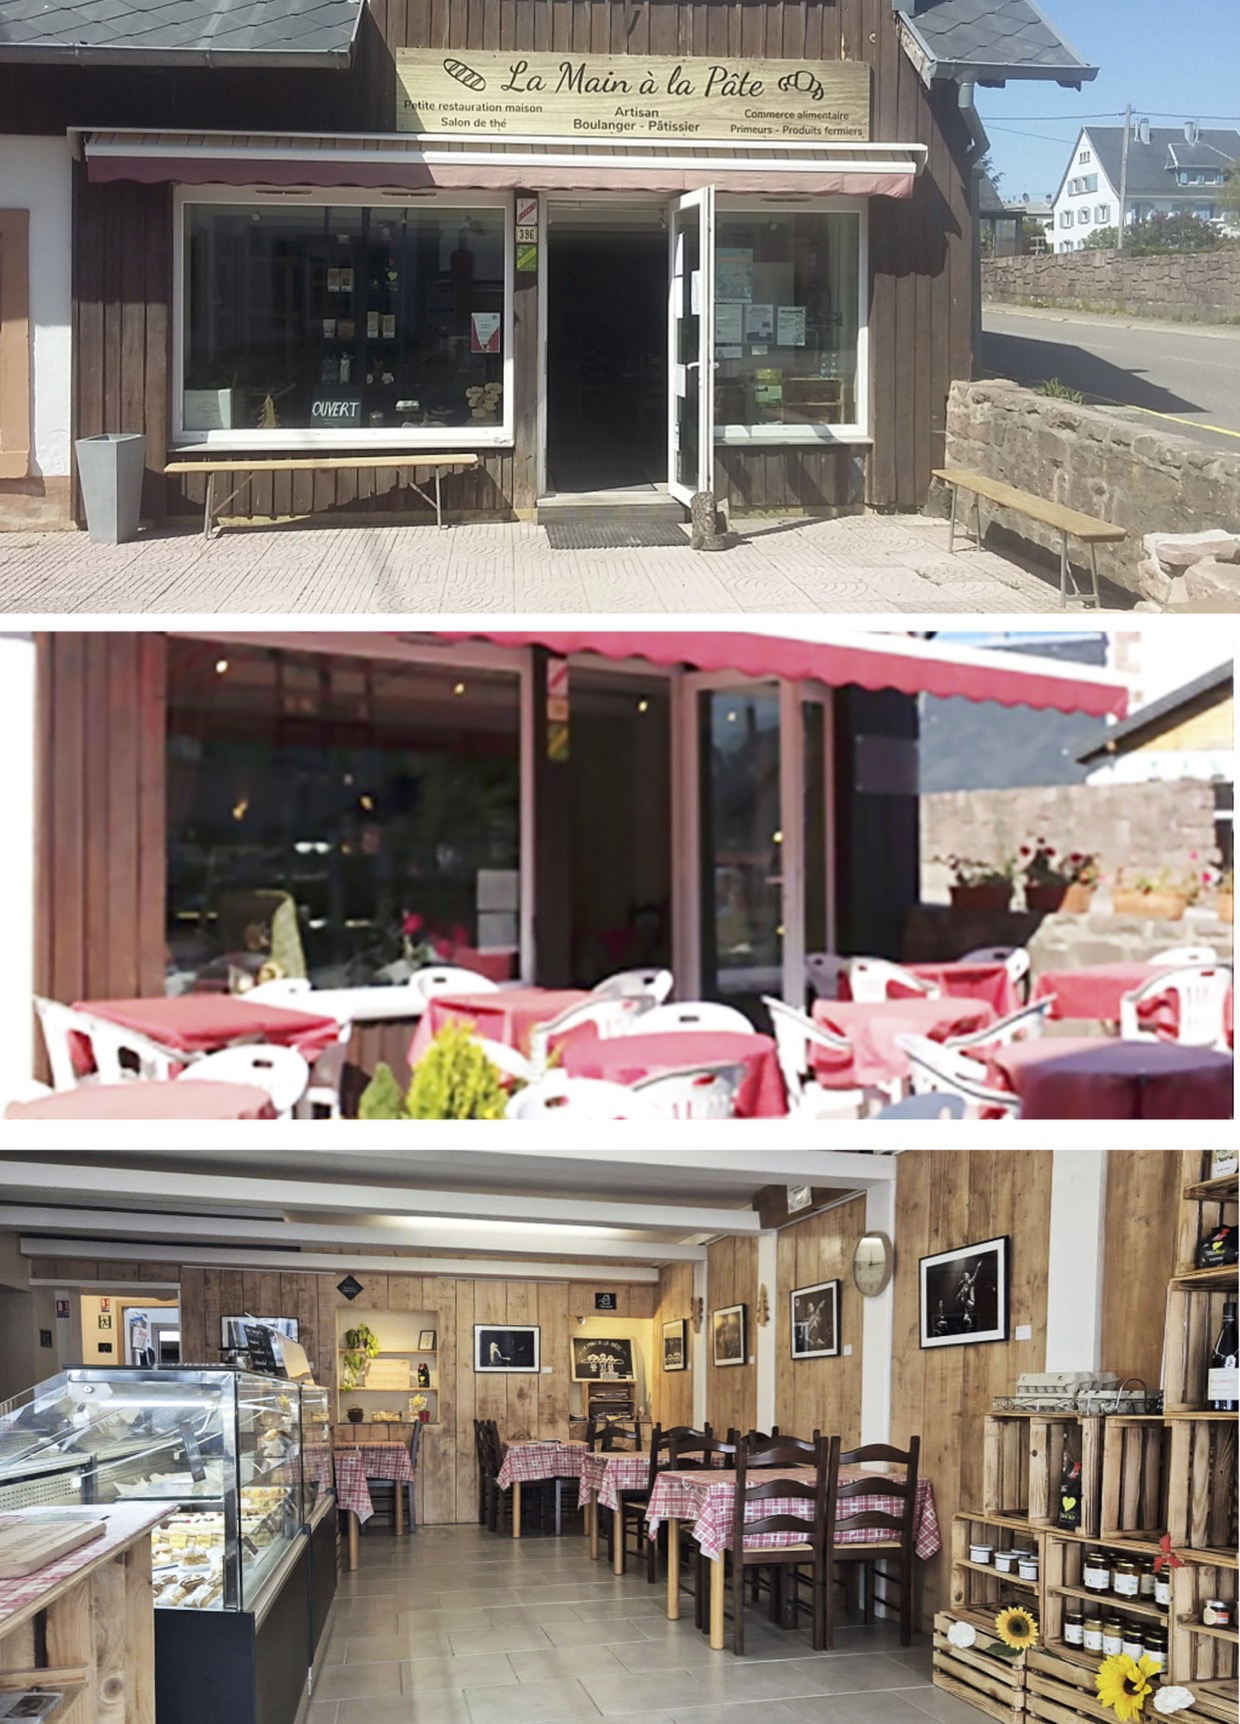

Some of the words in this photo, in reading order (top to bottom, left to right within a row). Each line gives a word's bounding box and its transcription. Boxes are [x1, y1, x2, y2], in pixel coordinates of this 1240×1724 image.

[500, 60, 547, 93] La
[555, 61, 633, 94] Main
[638, 70, 659, 95] à
[667, 65, 696, 95] la
[704, 65, 765, 98] Pâte
[404, 99, 436, 111] Petite
[438, 101, 502, 113] restauration
[505, 102, 543, 113] maison
[614, 106, 660, 118] Artisan
[744, 108, 795, 119] Commerce
[797, 110, 849, 120] alimentaire
[441, 117, 471, 127] Salon
[473, 117, 487, 128] de
[489, 117, 507, 128] thé
[573, 118, 636, 133] Boulanger
[648, 119, 700, 132] Pâtissier
[730, 124, 773, 134] Primeurs
[782, 125, 822, 135] Produits
[824, 126, 863, 136] fermiers
[519, 229, 535, 240] 396
[312, 401, 360, 417] OUVERT
